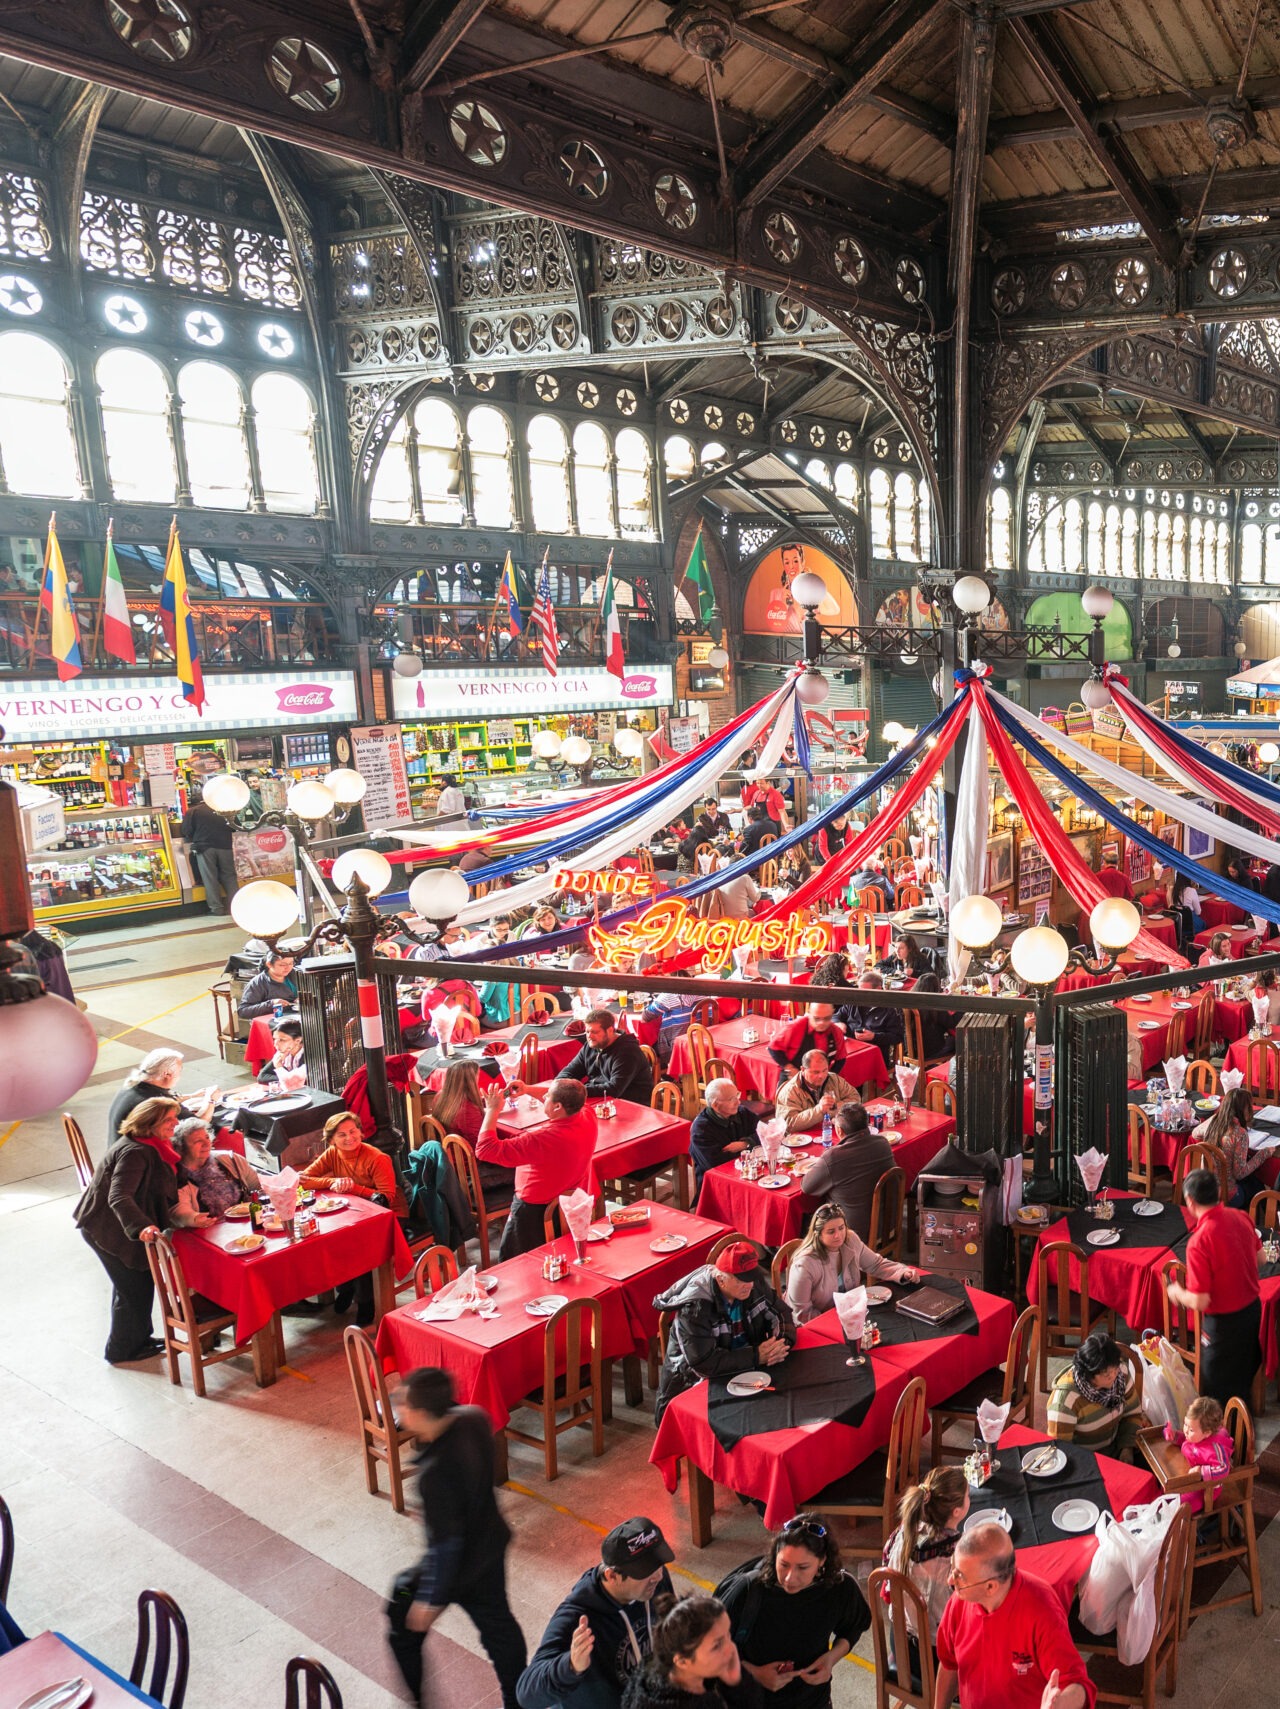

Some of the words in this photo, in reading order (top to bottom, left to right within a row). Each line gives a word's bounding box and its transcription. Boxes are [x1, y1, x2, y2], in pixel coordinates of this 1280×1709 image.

[457, 681, 547, 697] VERNENGO
[552, 681, 559, 693] Y
[564, 680, 589, 693] CIA
[0, 696, 143, 717] VERNENGO
[150, 695, 164, 710] Y
[283, 691, 326, 708] Coca-Cola
[28, 719, 61, 728] VINOS
[70, 717, 111, 727] LICORES
[119, 713, 187, 724] DELICATESSEN
[257, 832, 284, 846] Coca-Cola
[552, 869, 651, 895] DONDE
[588, 897, 834, 974] Augusto
